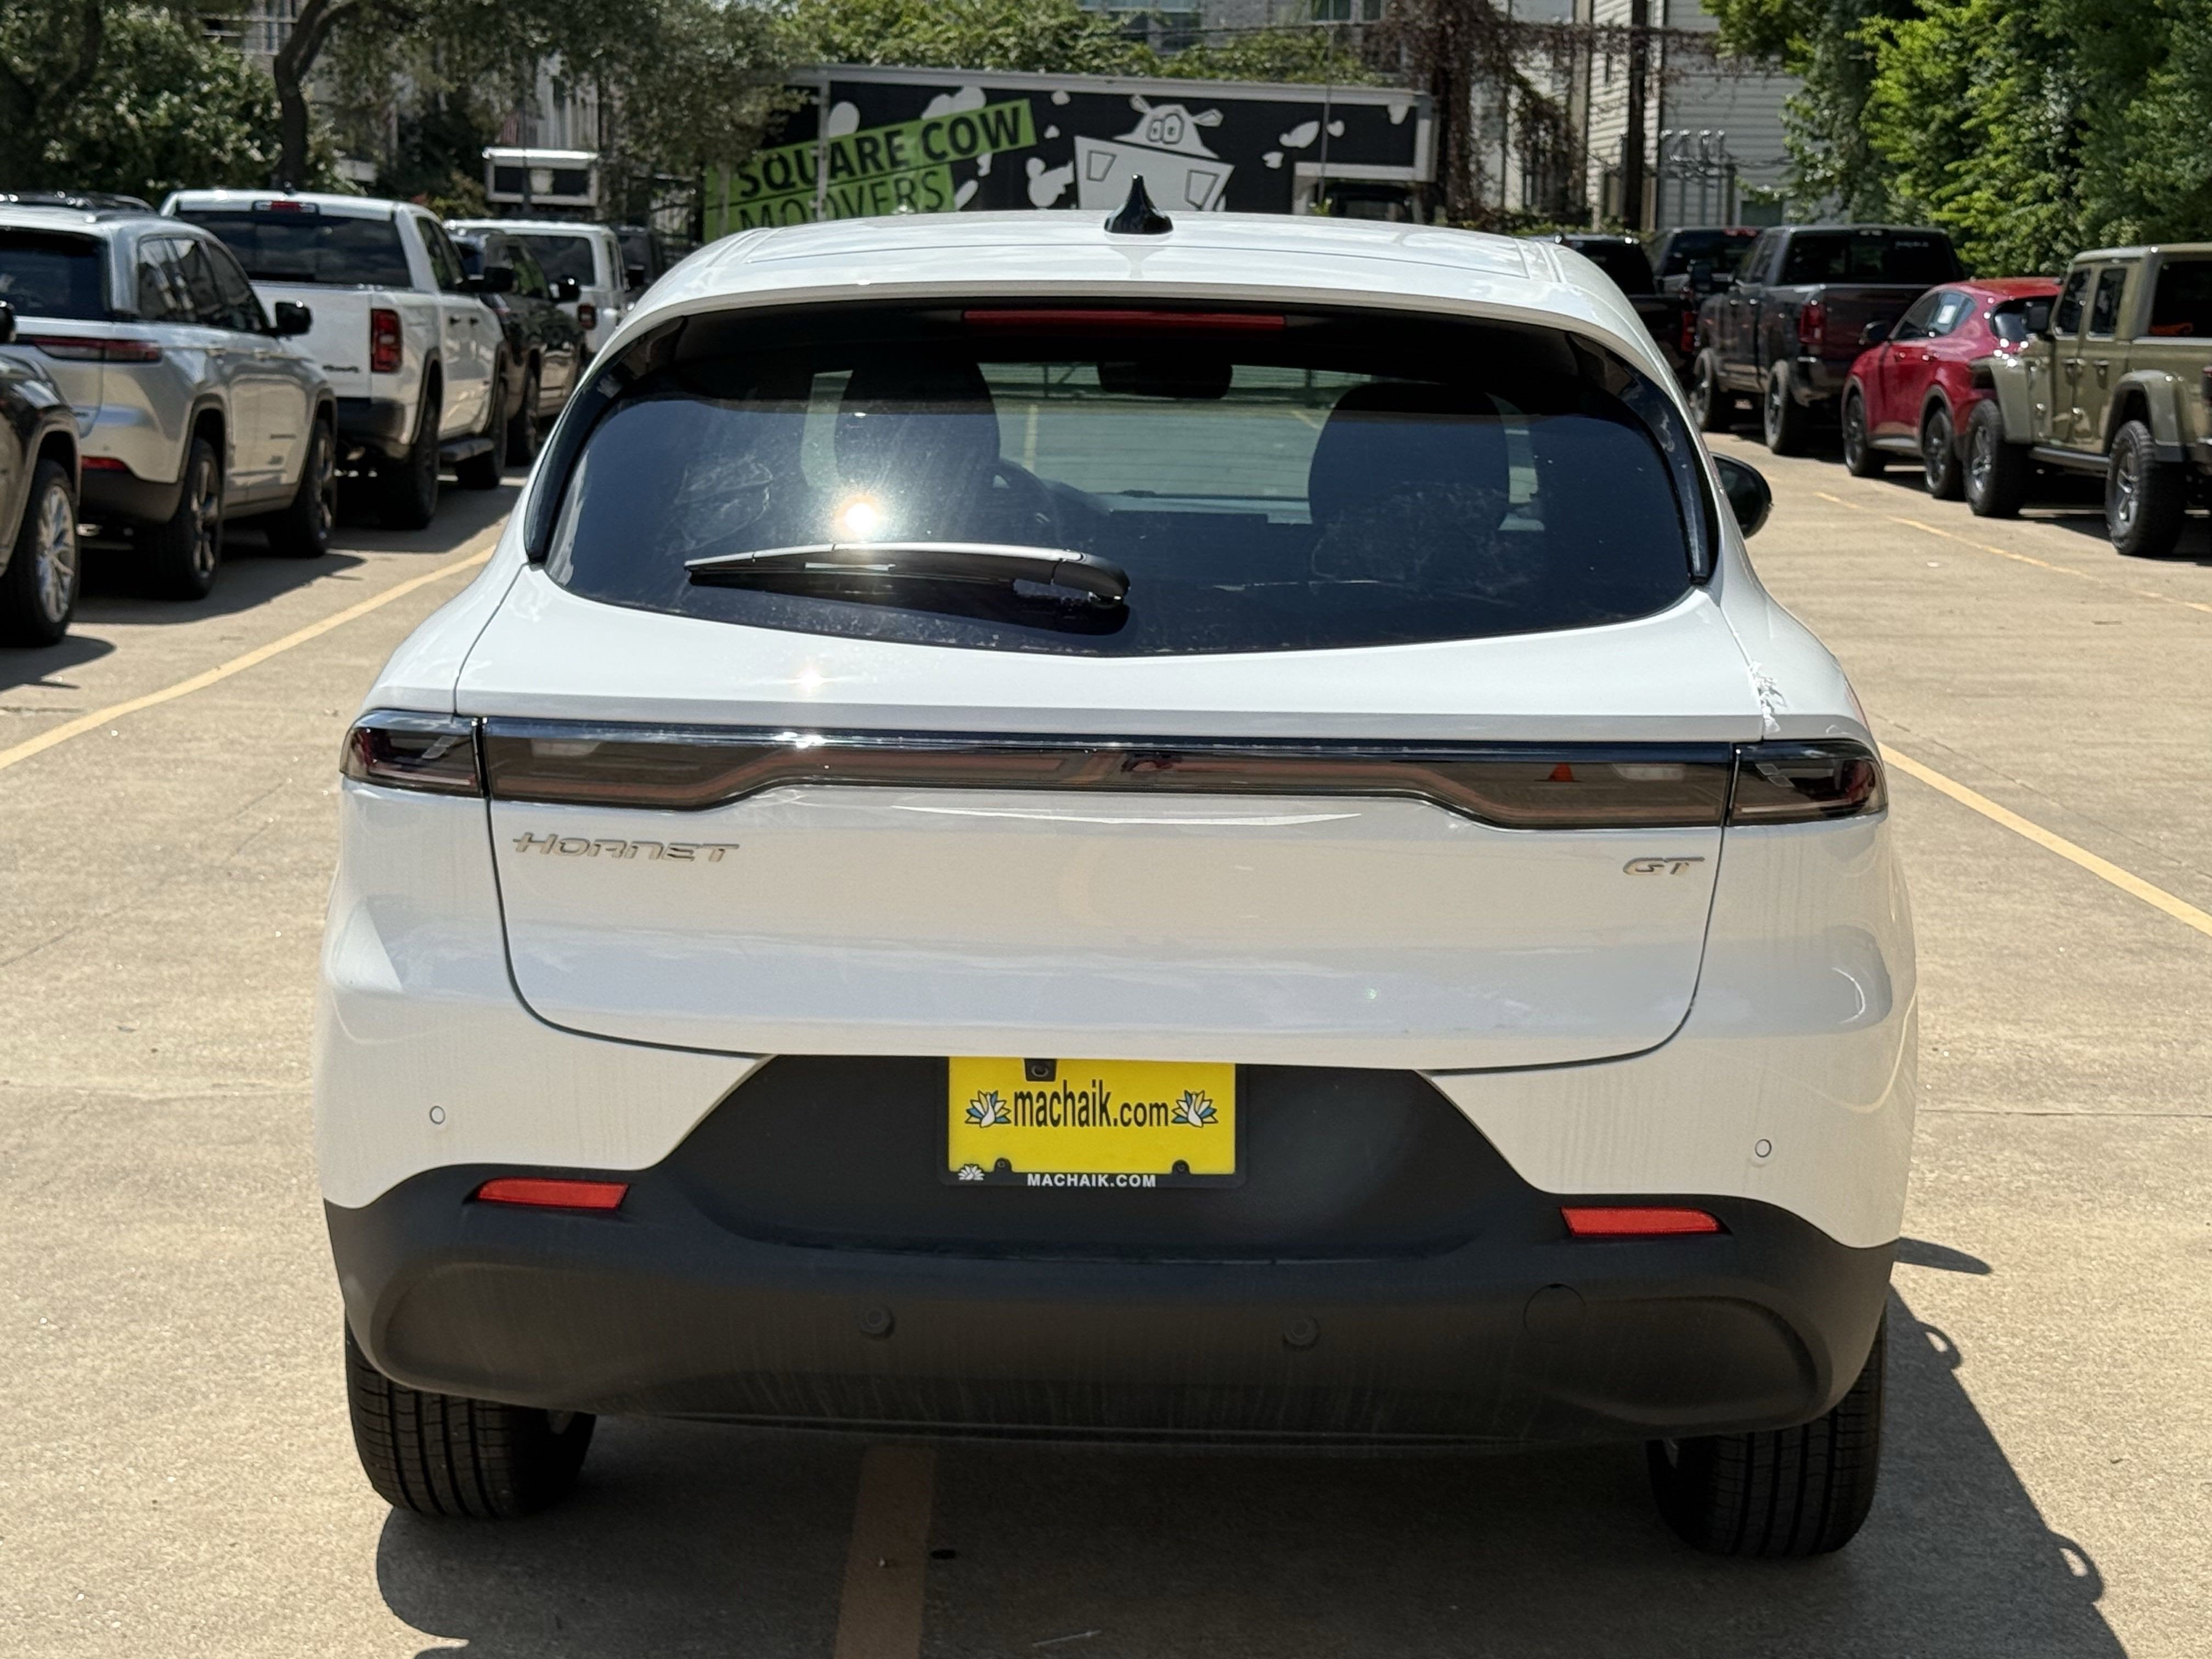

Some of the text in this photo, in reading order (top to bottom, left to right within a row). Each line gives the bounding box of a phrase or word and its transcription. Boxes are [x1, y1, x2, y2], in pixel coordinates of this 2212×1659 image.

[738, 106, 1020, 198] SQUARE COW
[512, 831, 740, 862] HORNET
[1622, 856, 1705, 876] GT
[1014, 1079, 1169, 1127] machaik.com
[1027, 1173, 1156, 1188] MACHAIK.COM
